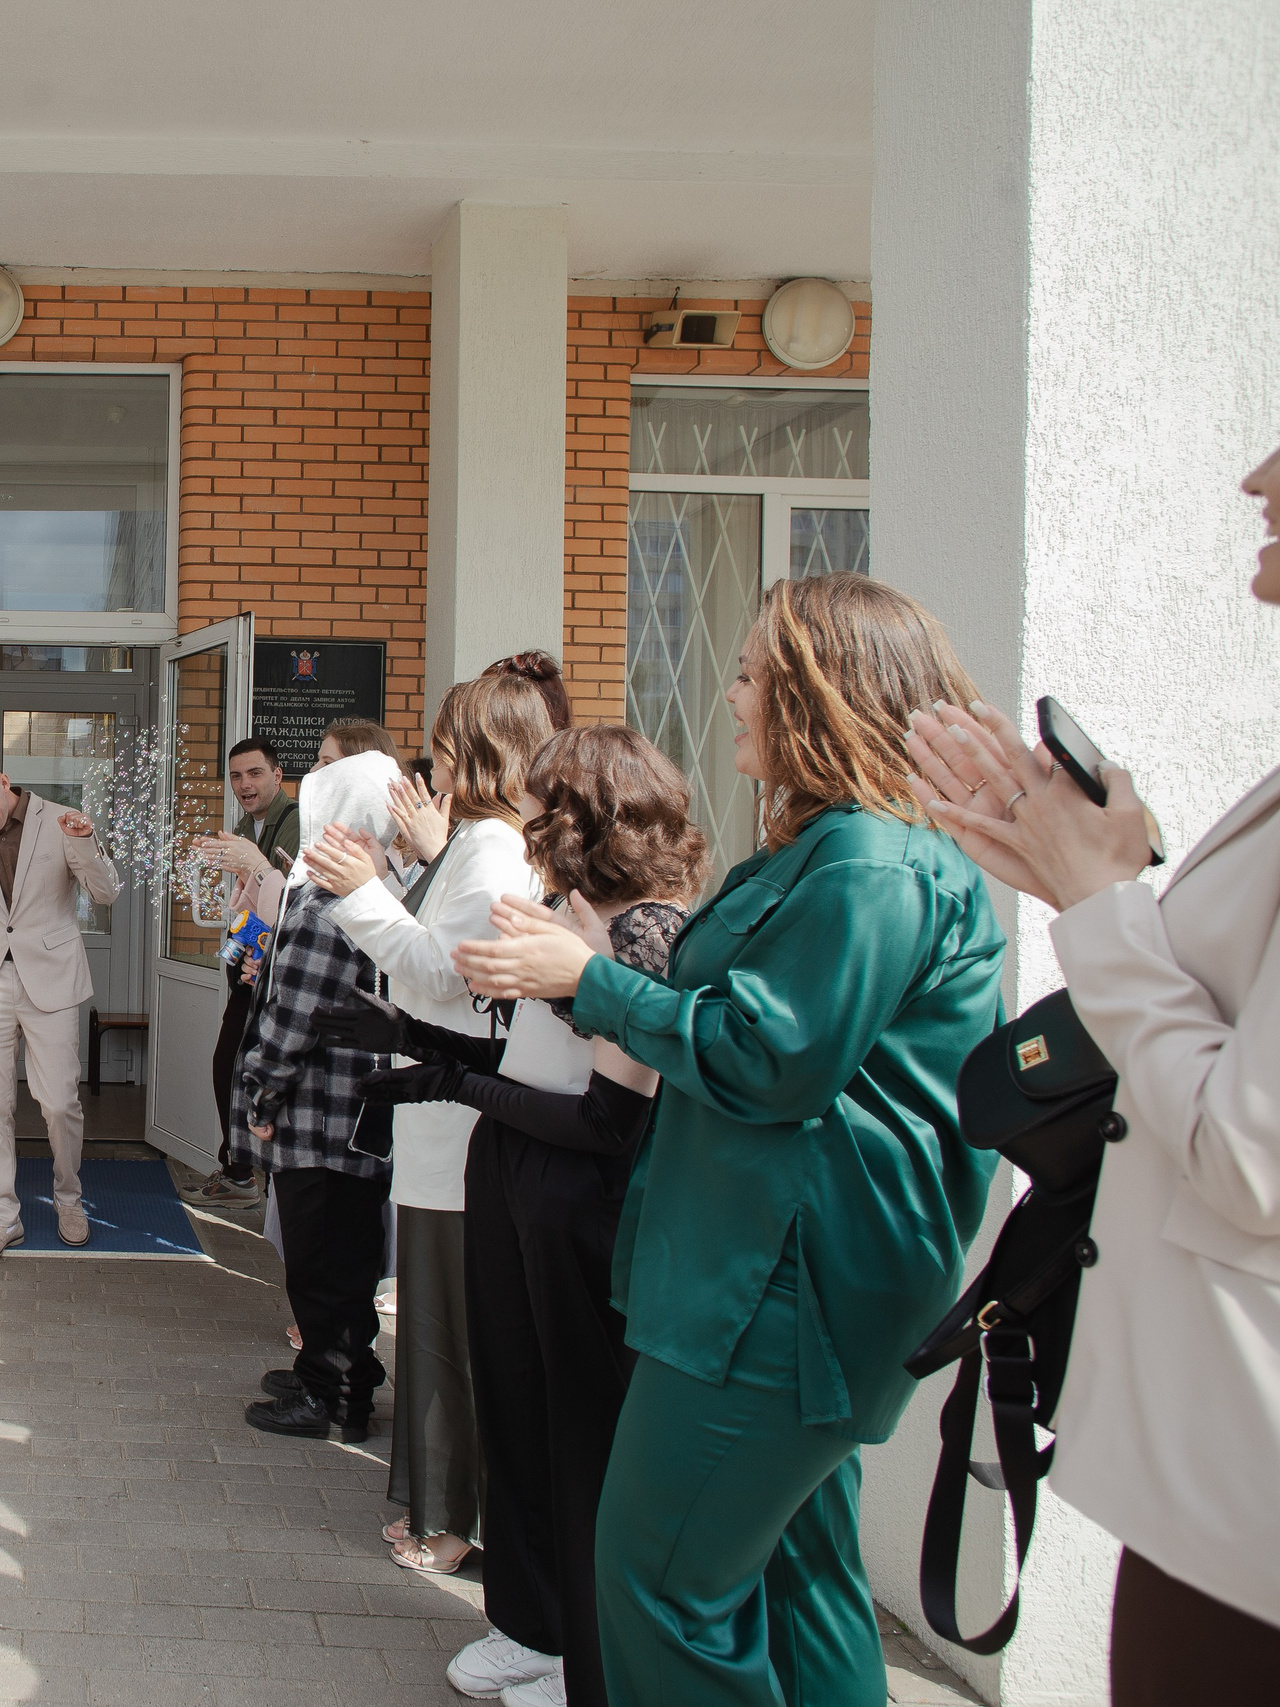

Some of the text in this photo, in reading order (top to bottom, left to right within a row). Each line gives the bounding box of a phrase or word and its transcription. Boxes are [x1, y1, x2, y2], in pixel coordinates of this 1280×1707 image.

[253, 715, 277, 725] ДЕЛ
[282, 716, 325, 726] ЗАПИСИ
[259, 727, 327, 738] ГРАЖДАНСК
[270, 739, 322, 749] СОСТОЯН
[277, 752, 315, 760] ОРСКОГО
